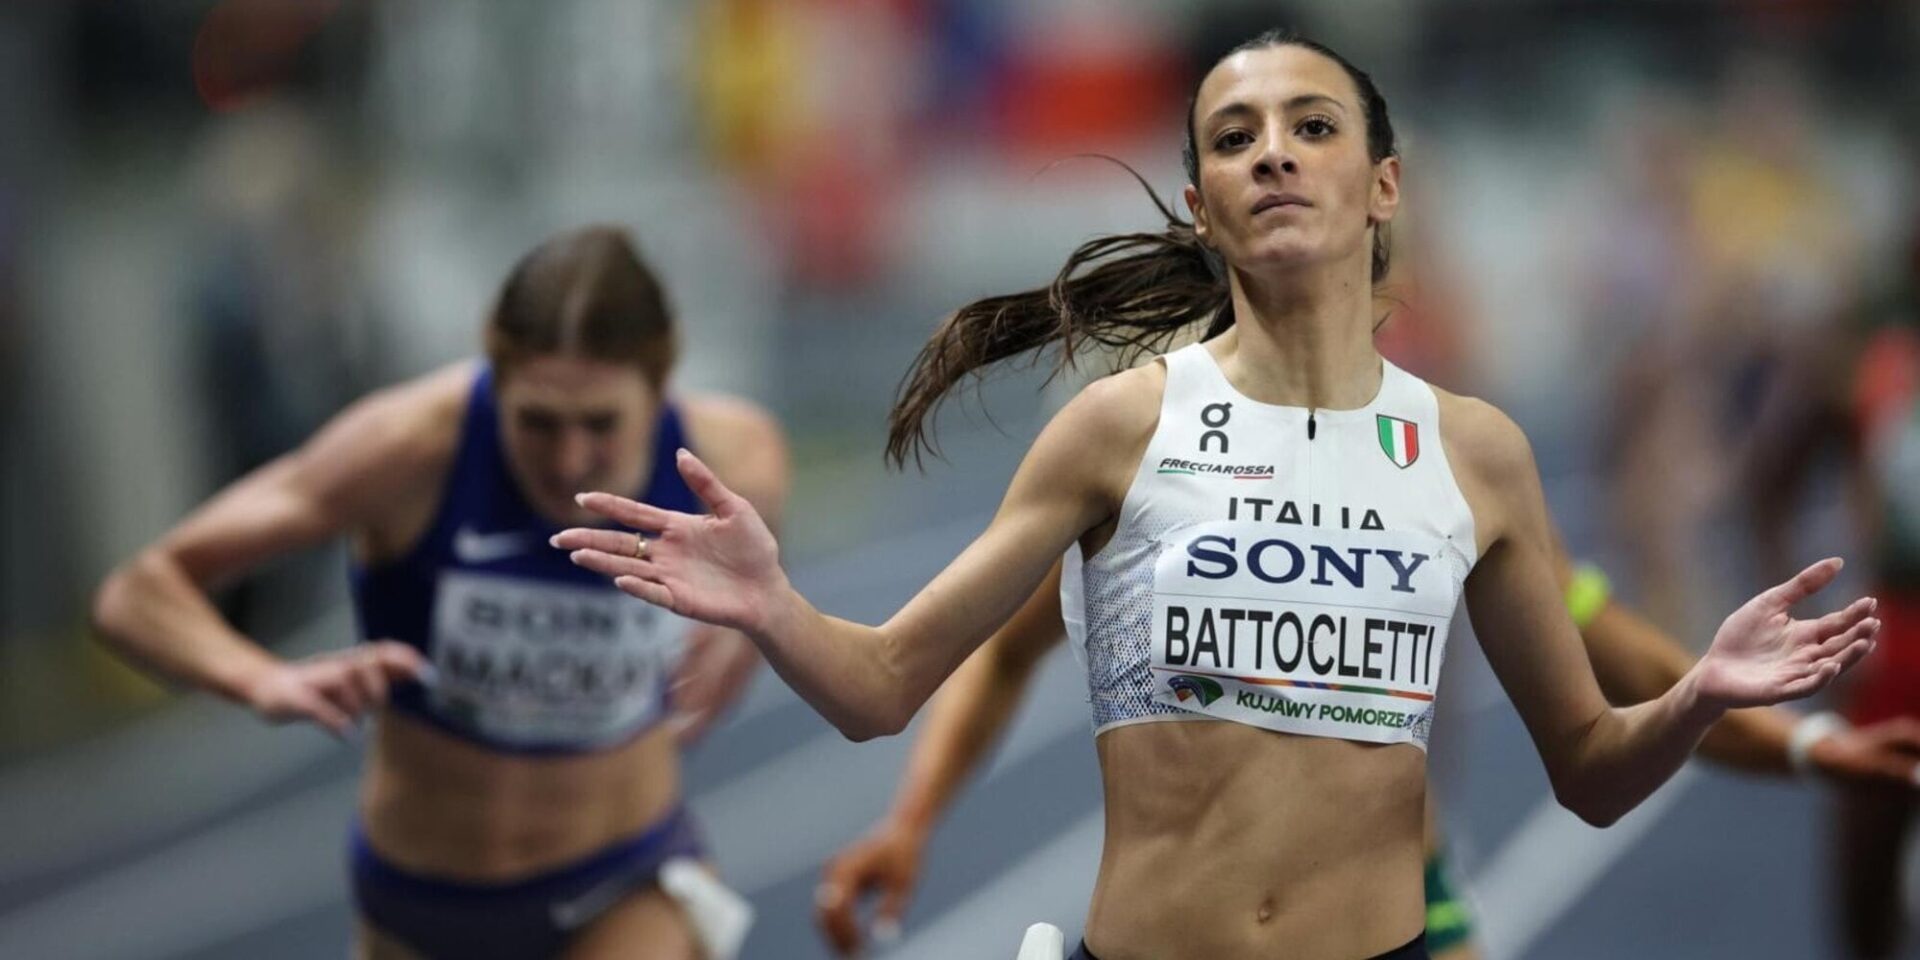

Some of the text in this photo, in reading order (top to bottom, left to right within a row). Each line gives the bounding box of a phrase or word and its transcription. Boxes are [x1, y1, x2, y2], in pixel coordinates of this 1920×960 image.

[1159, 458, 1275, 475] FRECCIAROSSA
[1186, 534, 1430, 594] SONY
[1164, 605, 1436, 686] BATTOCLETTI
[1236, 689, 1405, 728] KUJAWY POMORZE
